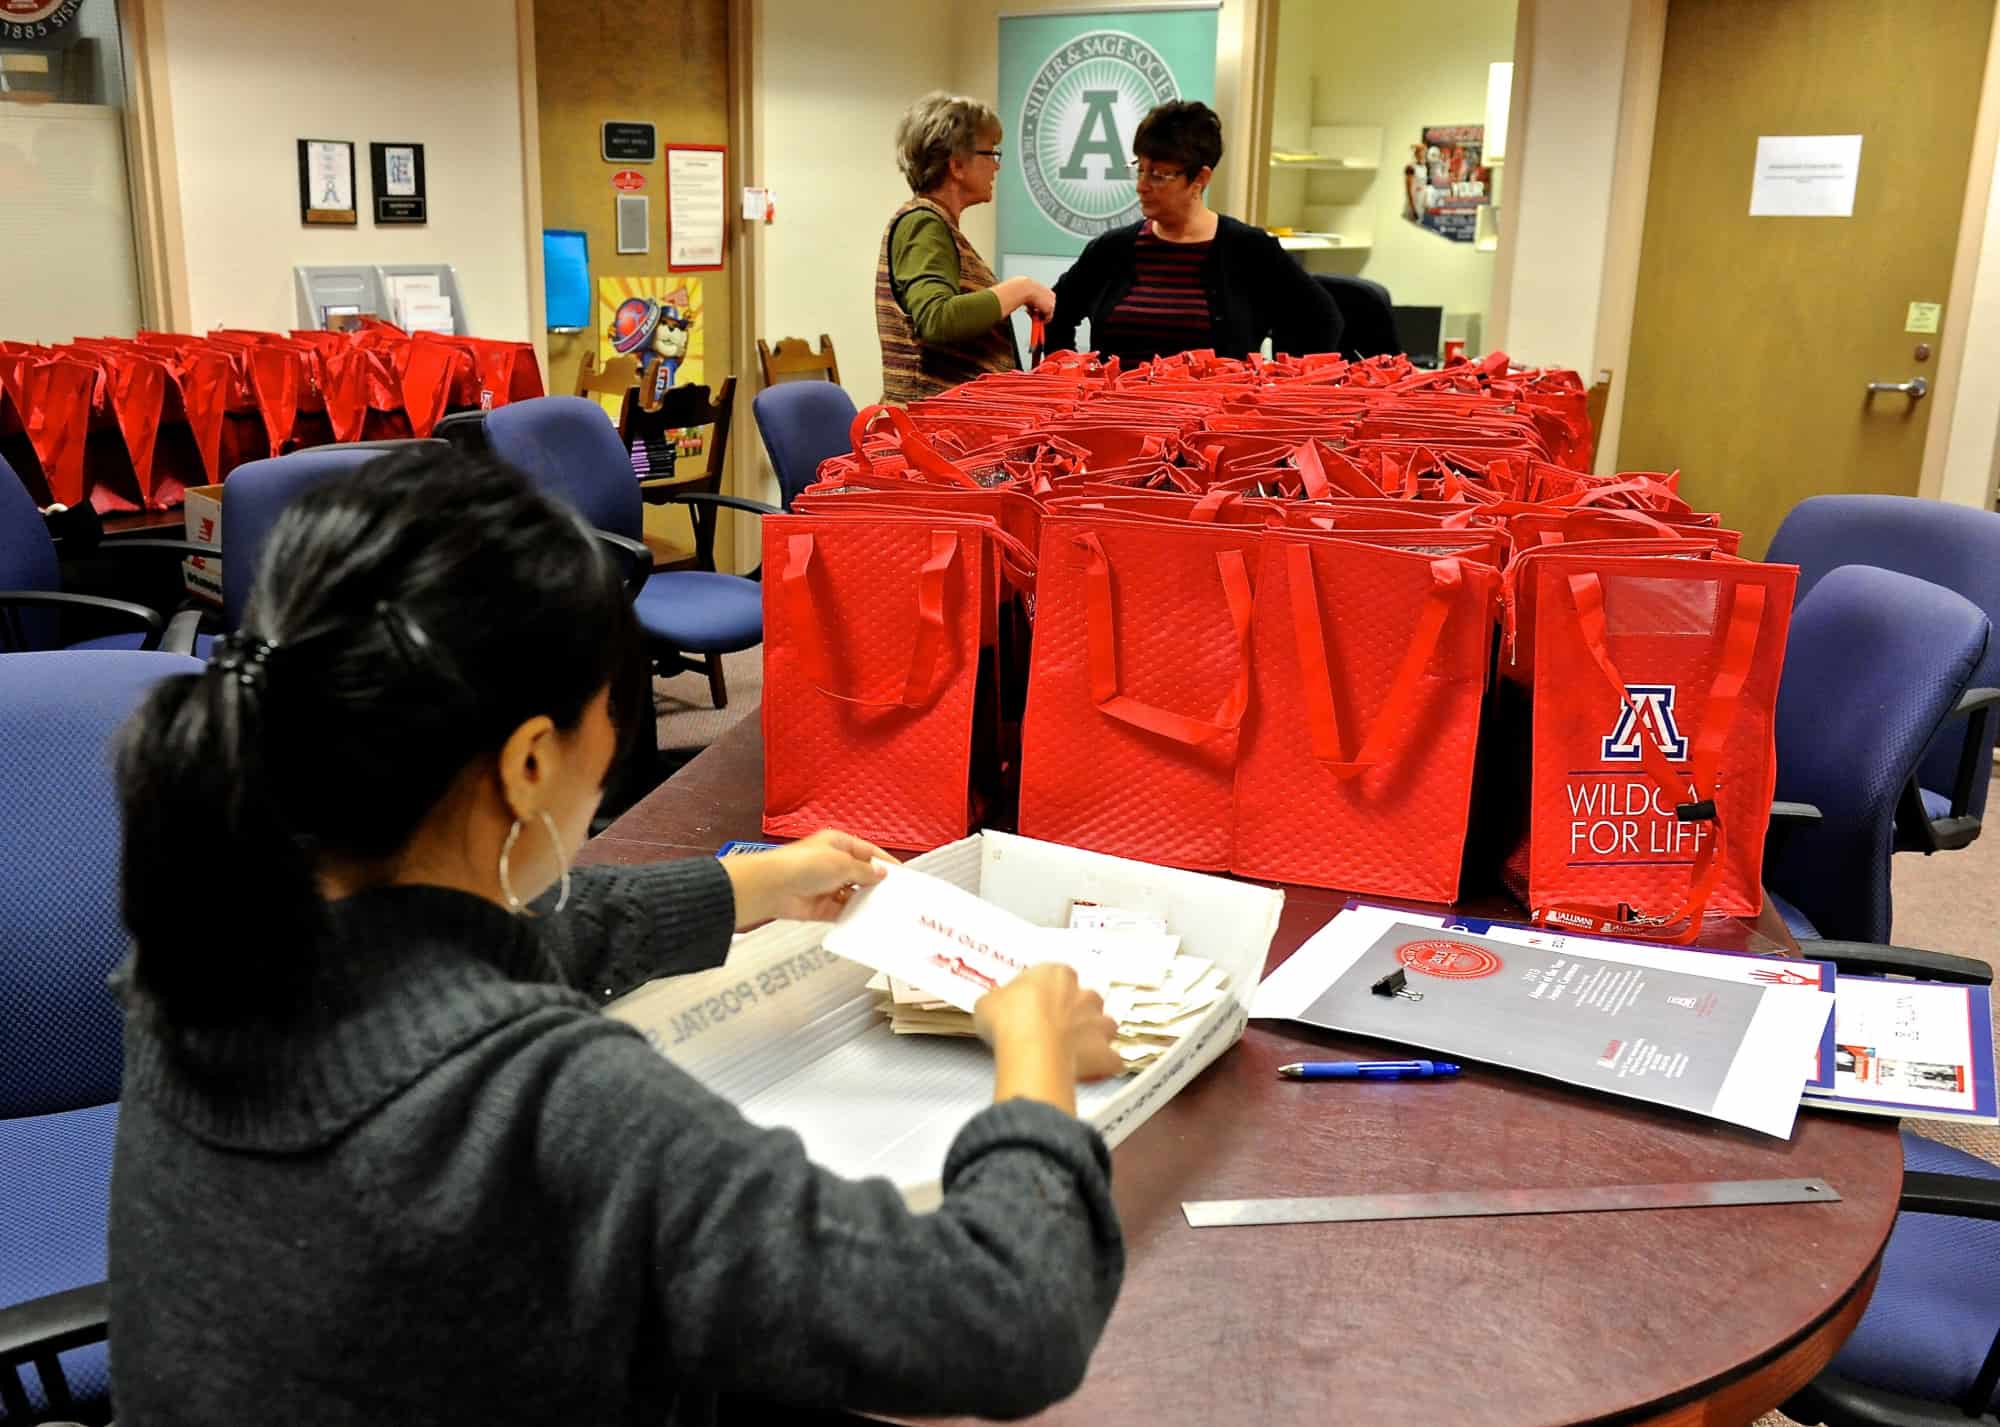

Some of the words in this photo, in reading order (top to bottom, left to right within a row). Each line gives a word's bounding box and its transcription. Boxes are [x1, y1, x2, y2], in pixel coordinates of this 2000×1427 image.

[4, 23, 47, 39] 1885
[1026, 57, 1068, 119] SILVER
[1067, 46, 1082, 65] &
[1082, 36, 1127, 57] SAGE
[1127, 44, 1177, 103] SOCIET
[1059, 90, 1132, 180] A
[1601, 684, 1688, 761] A
[1567, 784, 1720, 816] WILDC
[1571, 821, 1640, 855] FOR
[919, 914, 954, 938] SAVE
[958, 935, 990, 953] OLD
